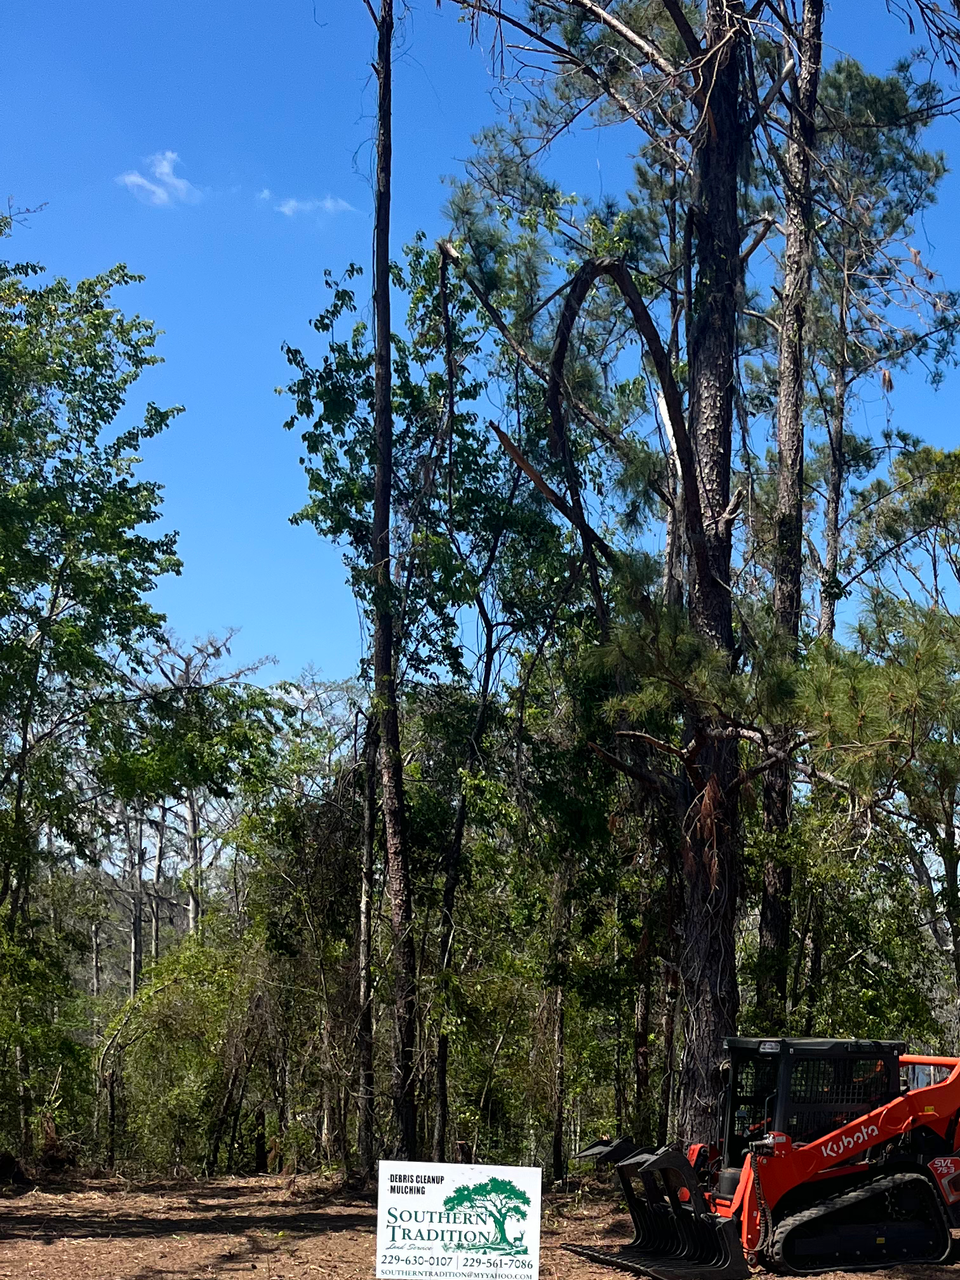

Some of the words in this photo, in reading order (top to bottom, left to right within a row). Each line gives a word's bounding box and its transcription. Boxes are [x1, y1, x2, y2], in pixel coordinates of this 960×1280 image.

[821, 1125, 879, 1158] Kubota
[934, 1159, 954, 1167] SVL
[390, 1174, 414, 1183] DEBRIS
[415, 1175, 445, 1185] CLEANUP
[390, 1185, 426, 1195] MULCHING
[387, 1207, 488, 1225] SOUTHERN
[386, 1225, 491, 1243] TRADITION
[381, 1254, 453, 1267] 229-630-0107
[463, 1257, 533, 1269] 229-561-7086
[381, 1269, 532, 1280] SOUTHERNTRADITION@MYYAHOO.COM
